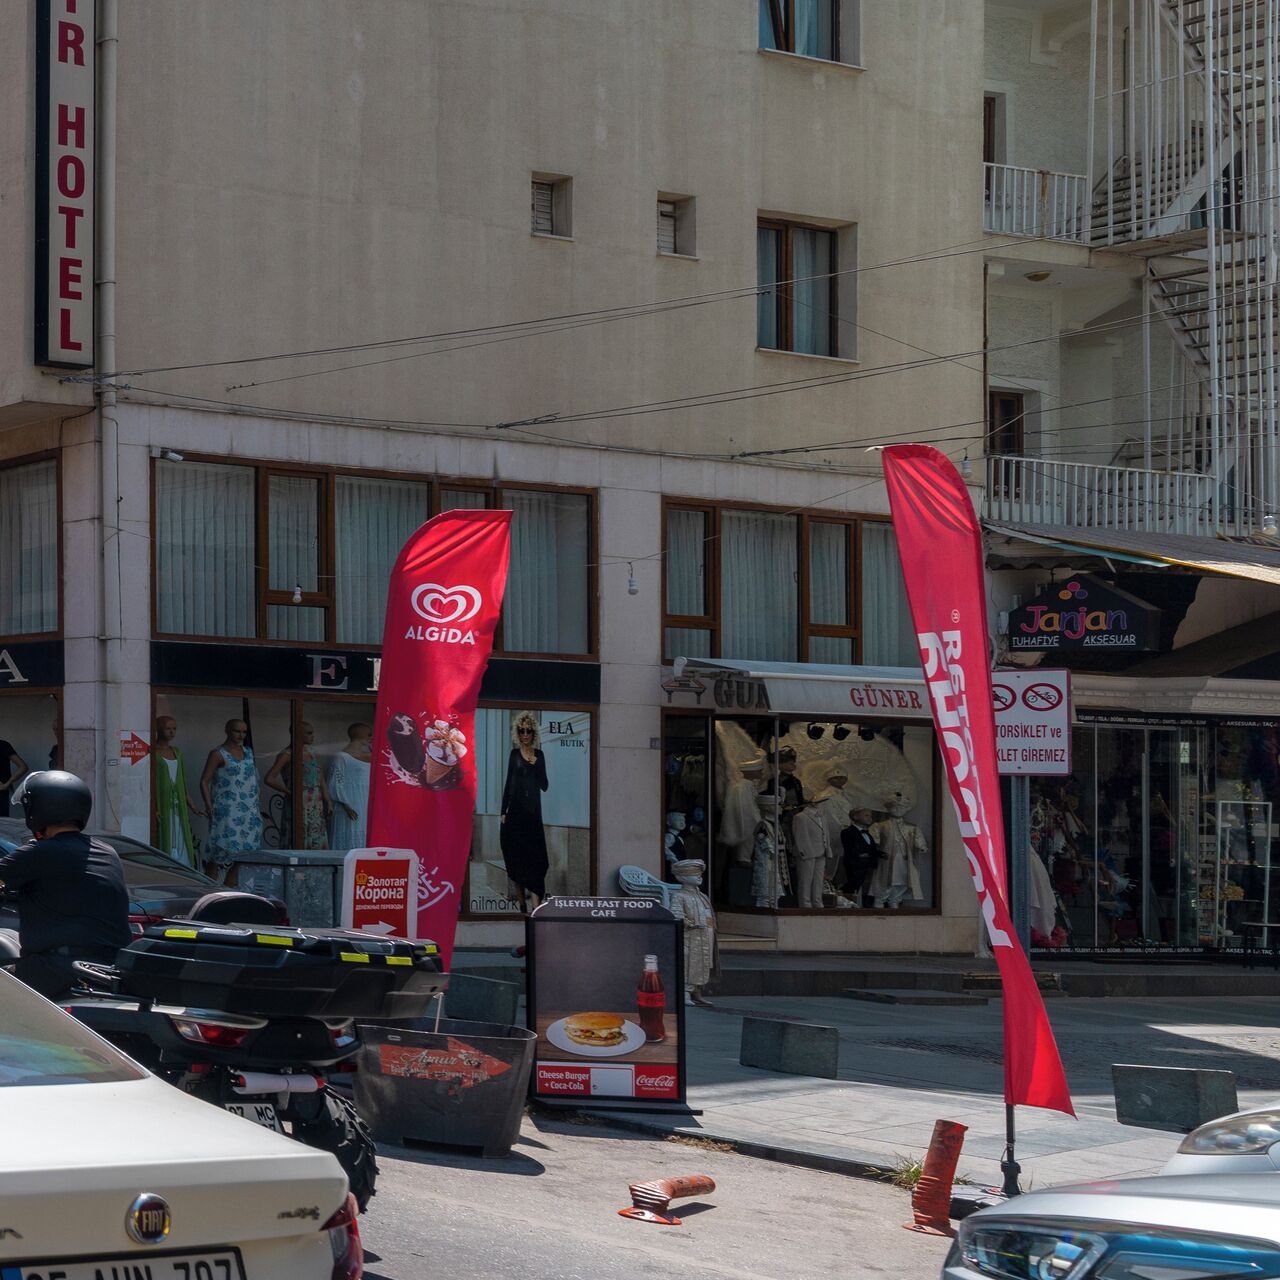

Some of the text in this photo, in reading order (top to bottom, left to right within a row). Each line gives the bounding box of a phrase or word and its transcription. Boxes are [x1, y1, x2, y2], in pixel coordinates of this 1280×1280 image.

[57, 104, 86, 352] HOTEL
[1020, 605, 1128, 640] Janjan
[1083, 635, 1137, 645] AKSESUAR
[850, 683, 923, 709] GÜNER
[549, 721, 575, 735] ELA
[995, 722, 1062, 738] TORSİKLET ve
[1021, 746, 1066, 762] GİREMEZ
[367, 875, 405, 887] Золотая
[355, 885, 404, 903] Корона
[554, 899, 653, 909] İŞLEYEN FAST FOOD
[538, 1070, 590, 1081] Cheese Burger
[635, 1074, 676, 1087] Coca-Cola
[550, 1081, 585, 1090] Coca-Cola
[253, 1106, 276, 1122] MC
[141, 1208, 166, 1233] FIAT
